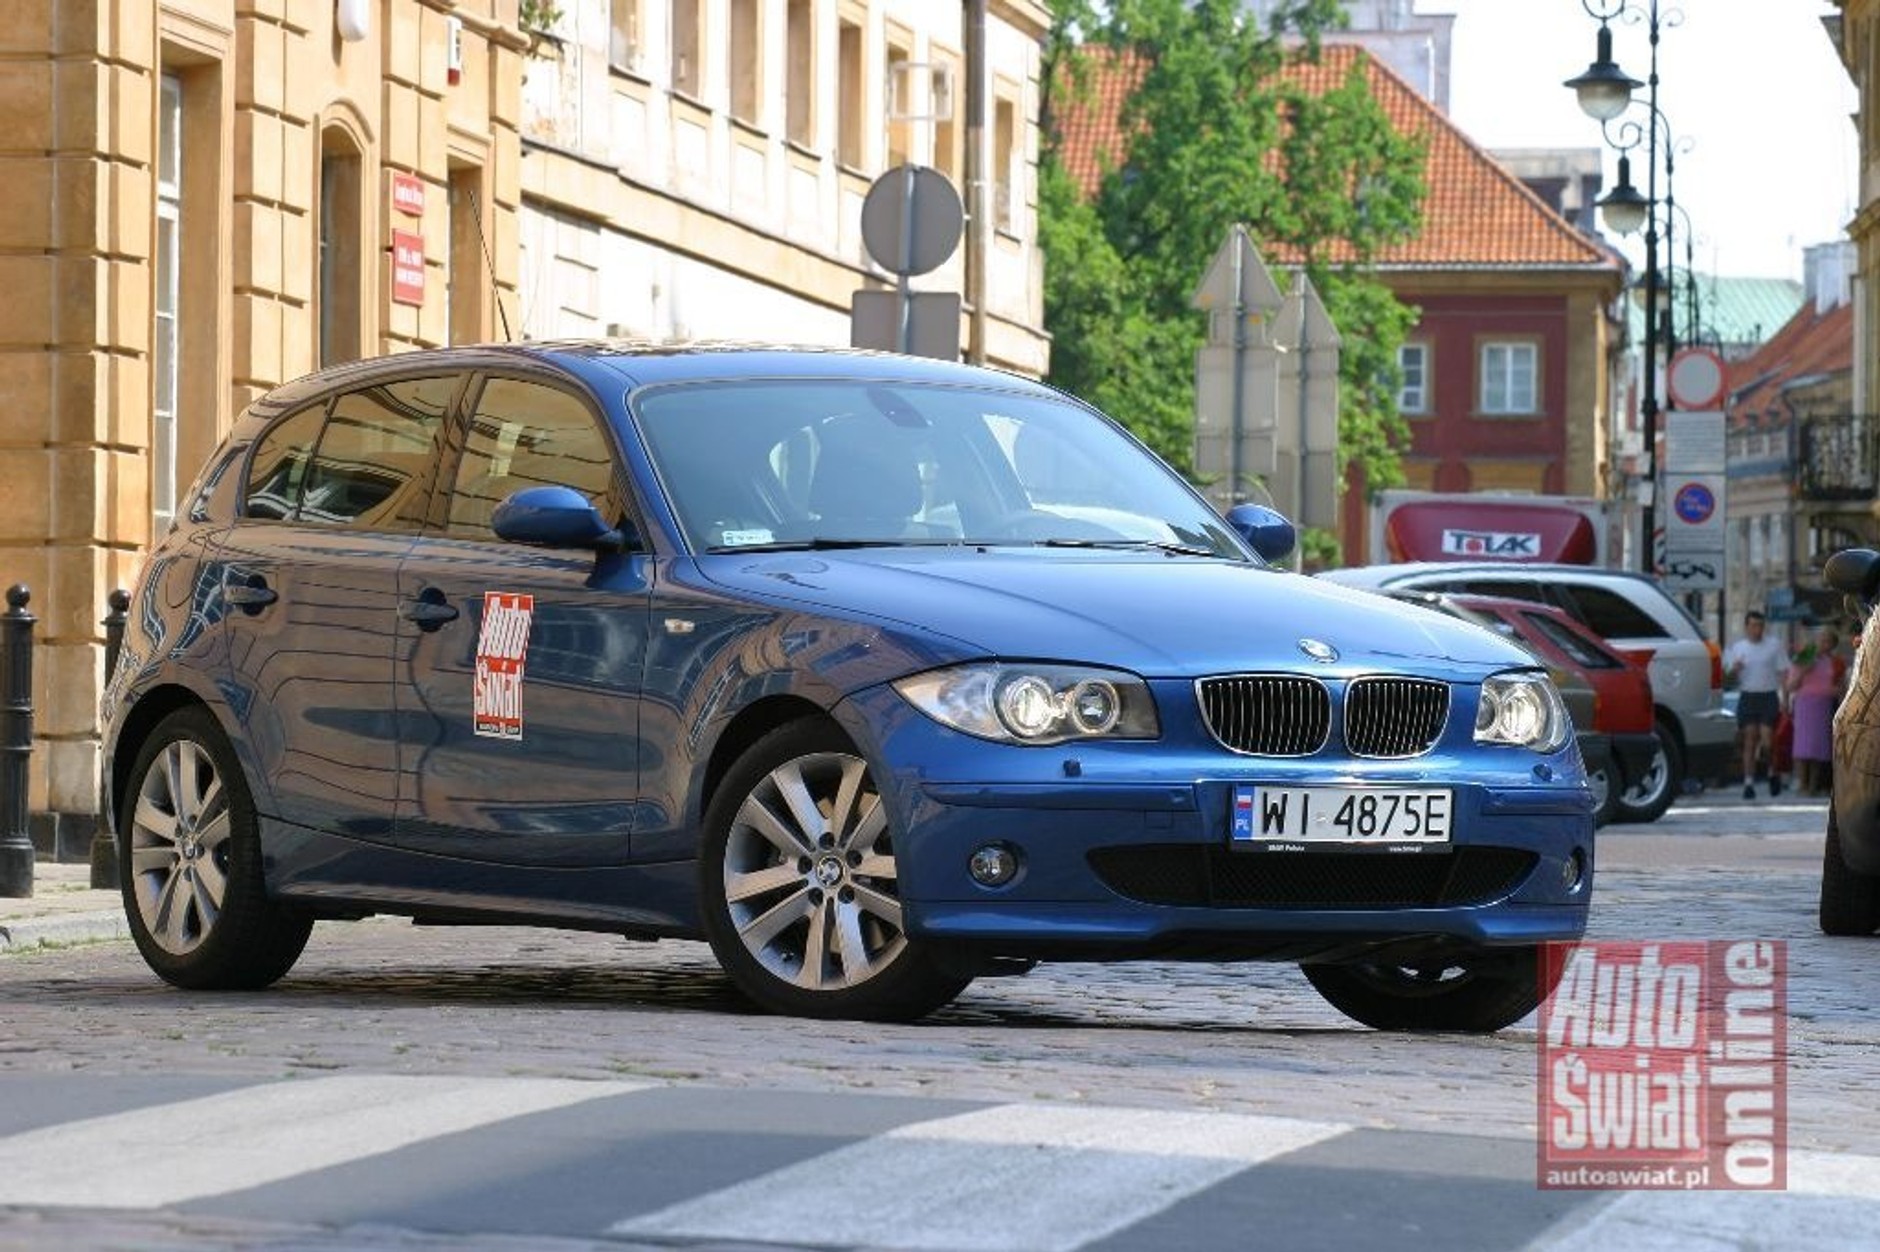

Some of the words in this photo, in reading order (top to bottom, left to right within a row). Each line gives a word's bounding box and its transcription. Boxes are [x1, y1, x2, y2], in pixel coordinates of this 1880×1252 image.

[478, 597, 531, 658] Auto
[1235, 818, 1250, 831] PL
[1334, 795, 1445, 836] 4875E
